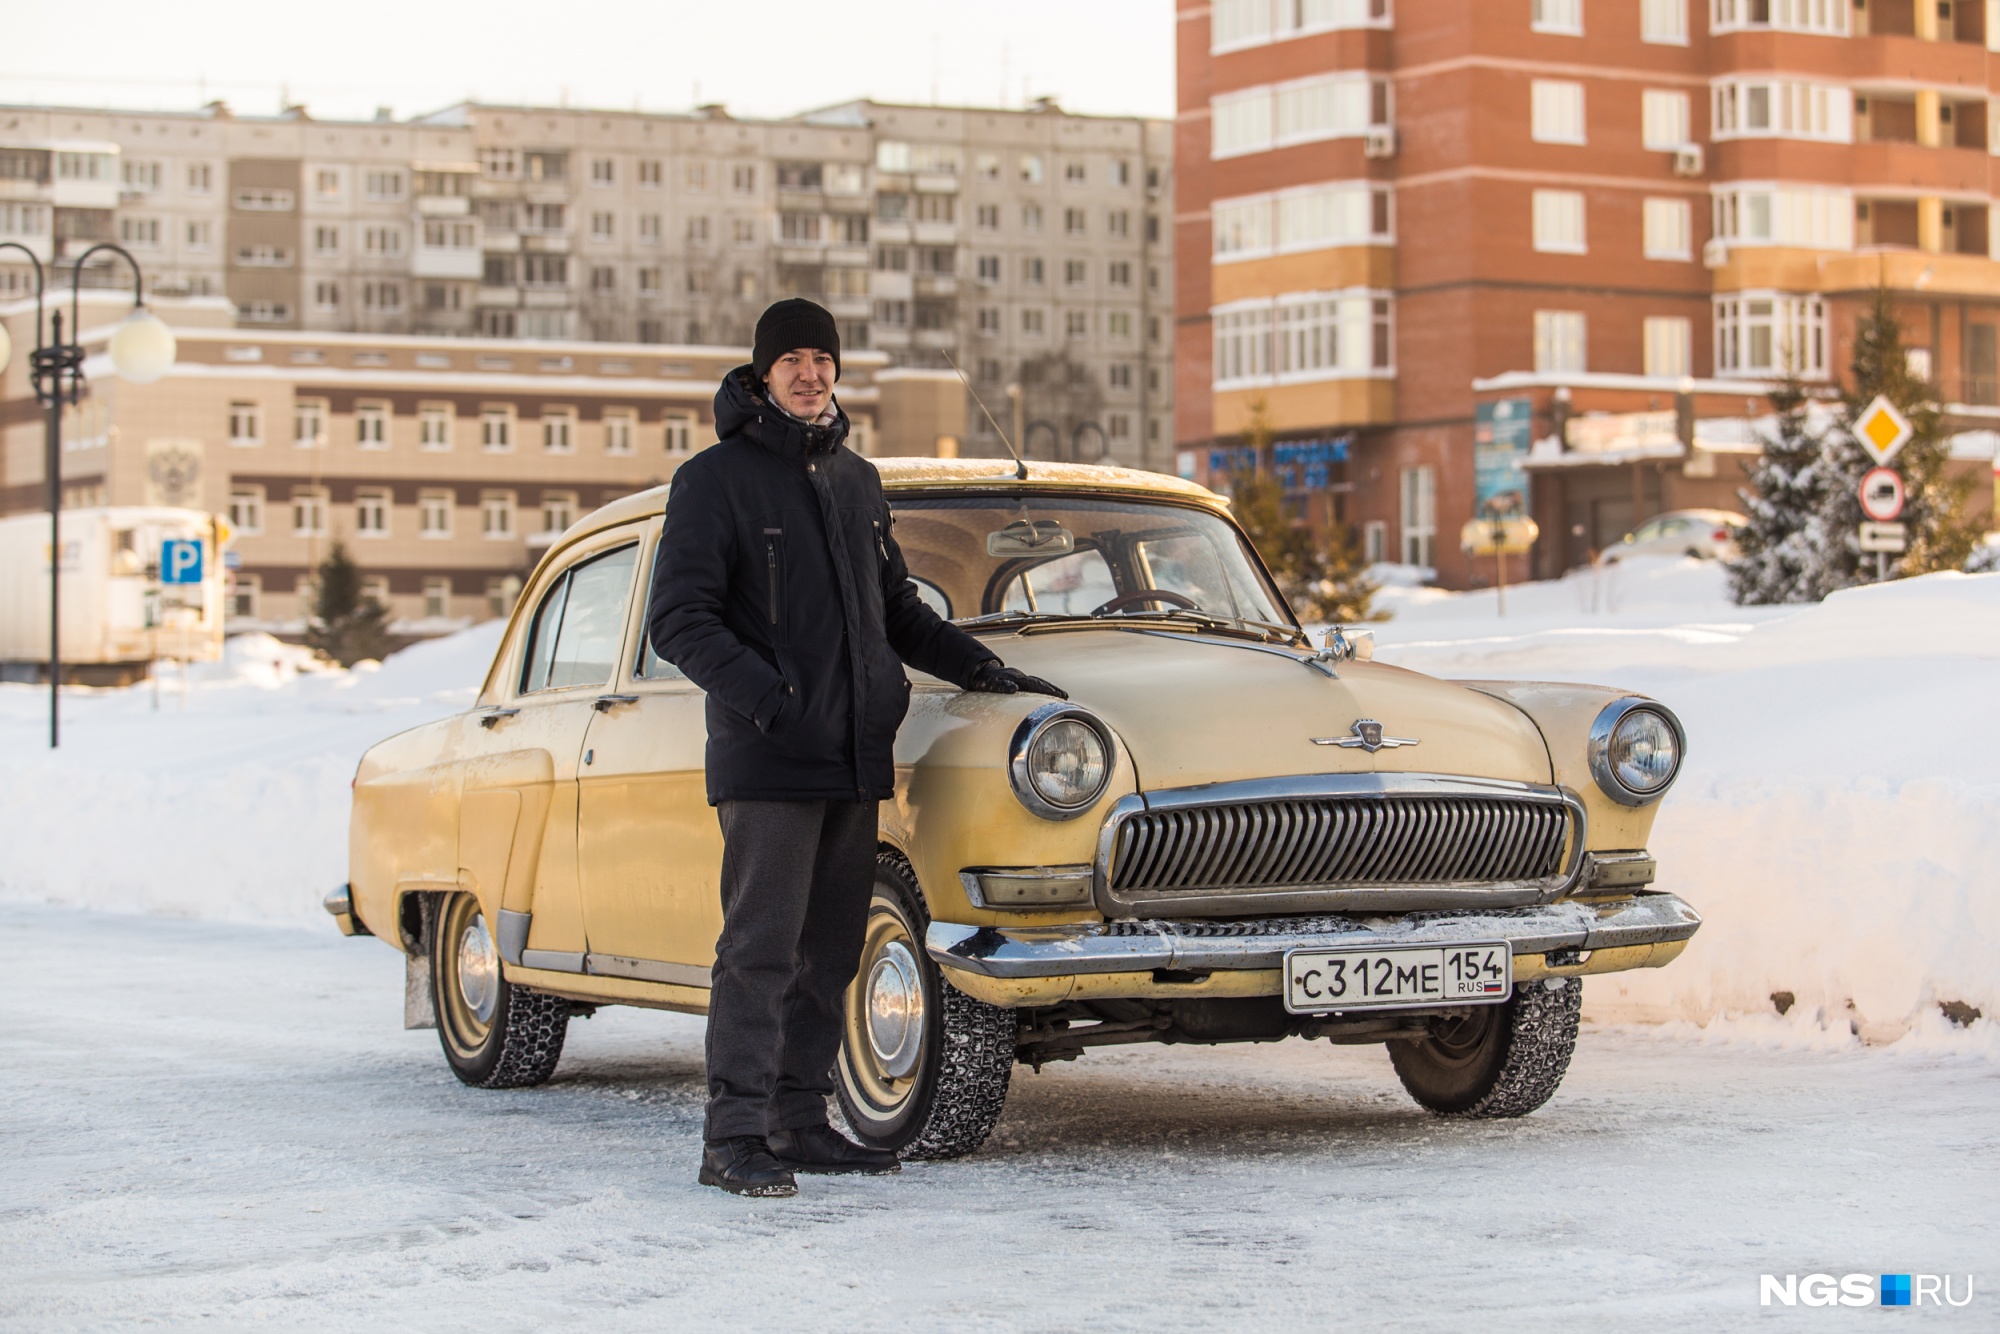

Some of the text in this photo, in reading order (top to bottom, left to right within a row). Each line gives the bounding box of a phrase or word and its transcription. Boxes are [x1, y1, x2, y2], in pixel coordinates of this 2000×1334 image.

[172, 542, 199, 581] P
[1449, 951, 1497, 980] 154
[1458, 981, 1483, 993] RUS
